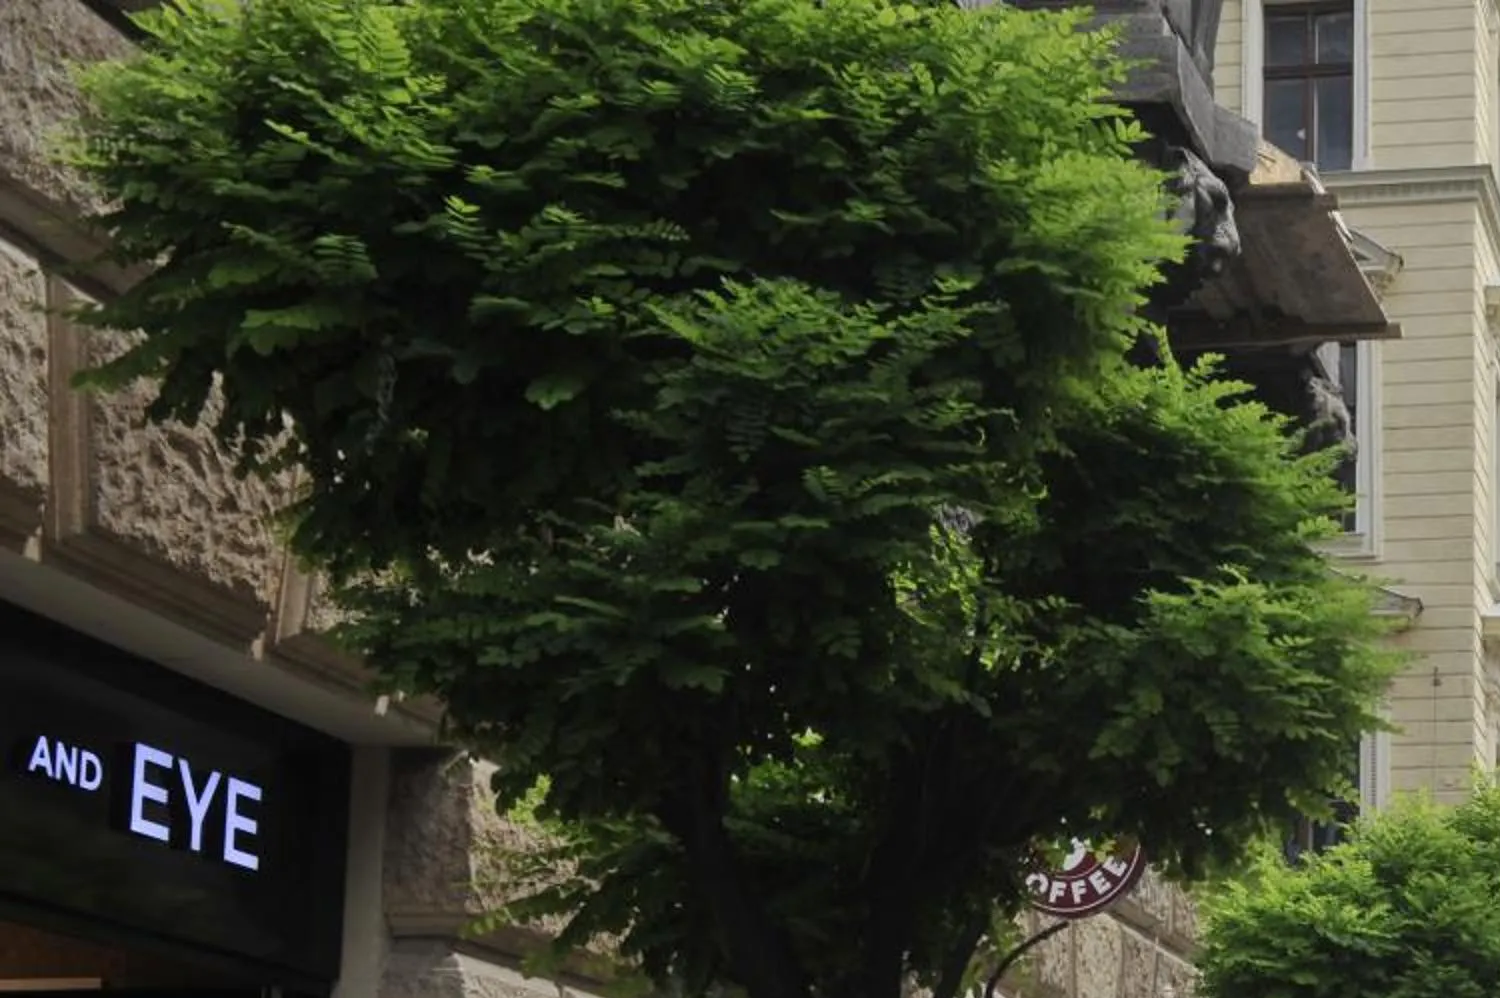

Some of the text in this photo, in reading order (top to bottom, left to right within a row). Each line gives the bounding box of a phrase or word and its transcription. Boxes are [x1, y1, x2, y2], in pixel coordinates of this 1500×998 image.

[28, 735, 263, 872] AND EYE
[1021, 855, 1128, 904] OFFEE
